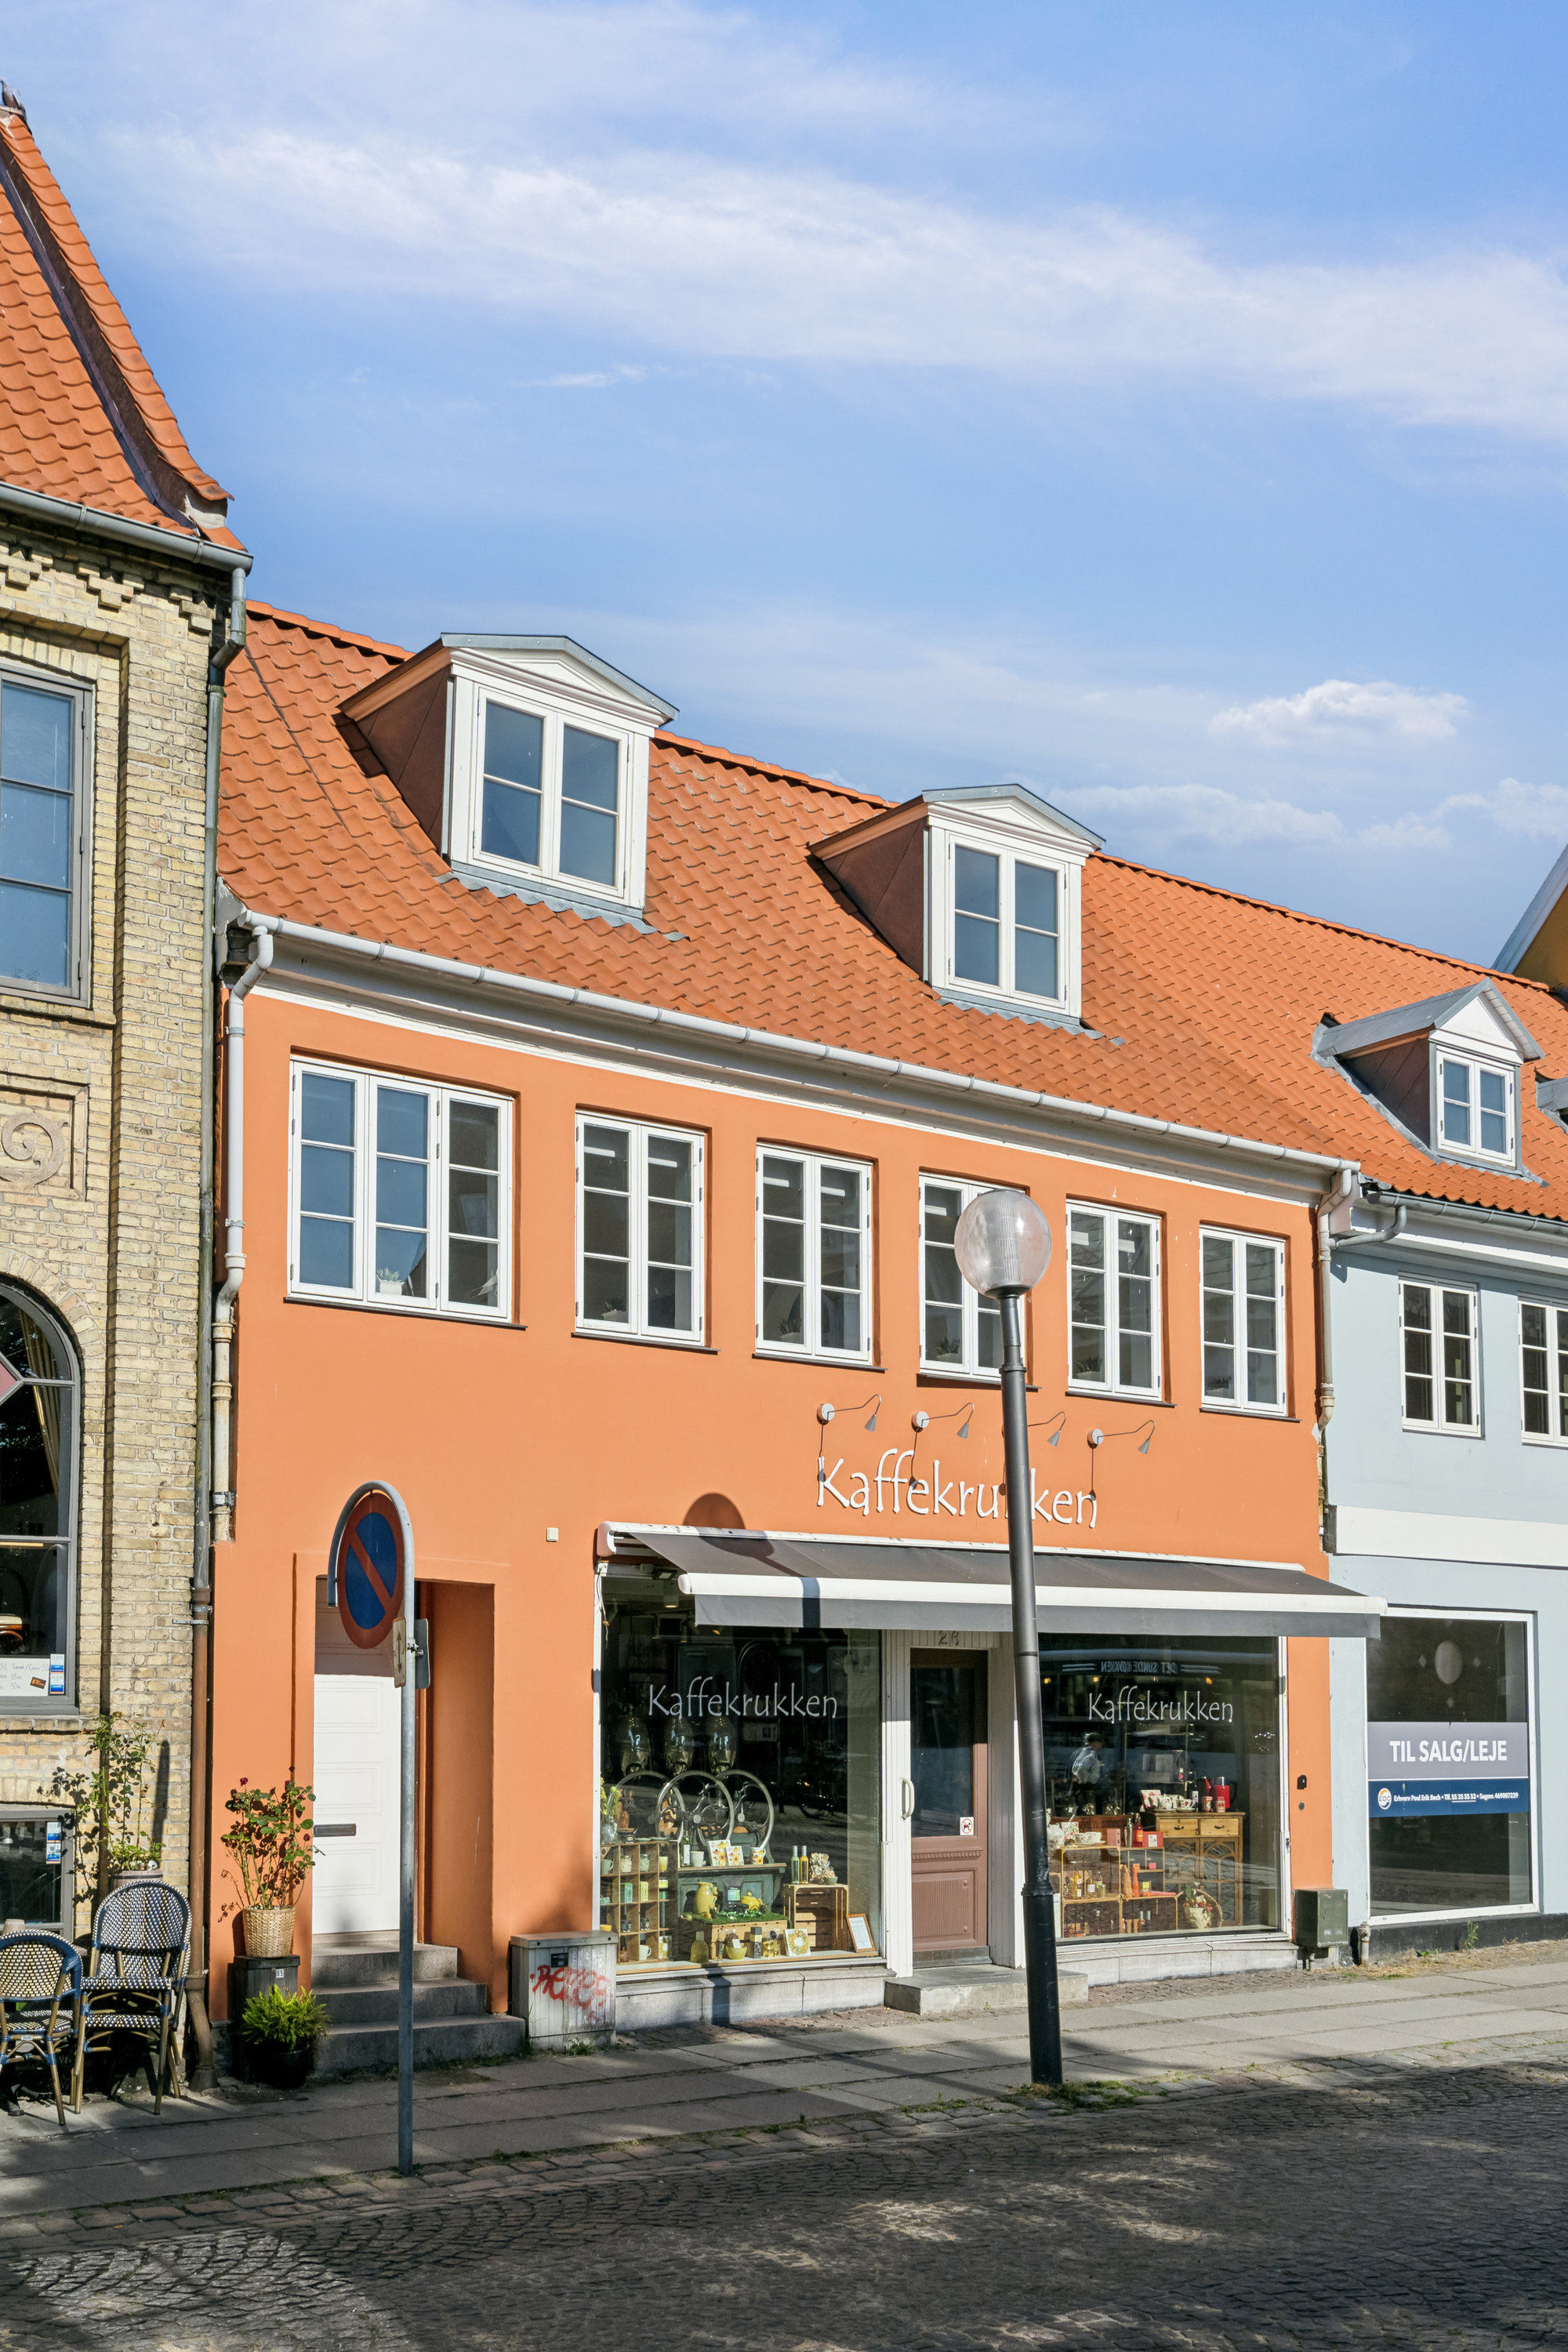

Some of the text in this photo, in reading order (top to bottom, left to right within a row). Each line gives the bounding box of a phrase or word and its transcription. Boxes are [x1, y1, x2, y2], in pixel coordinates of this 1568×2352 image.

[817, 1448, 1098, 1528] Kaffekruken
[648, 1676, 837, 1719] Kaffekrukken
[1088, 1686, 1233, 1724] Kaffekrukken
[1389, 1739, 1508, 1762] TIL SALG/LEJE
